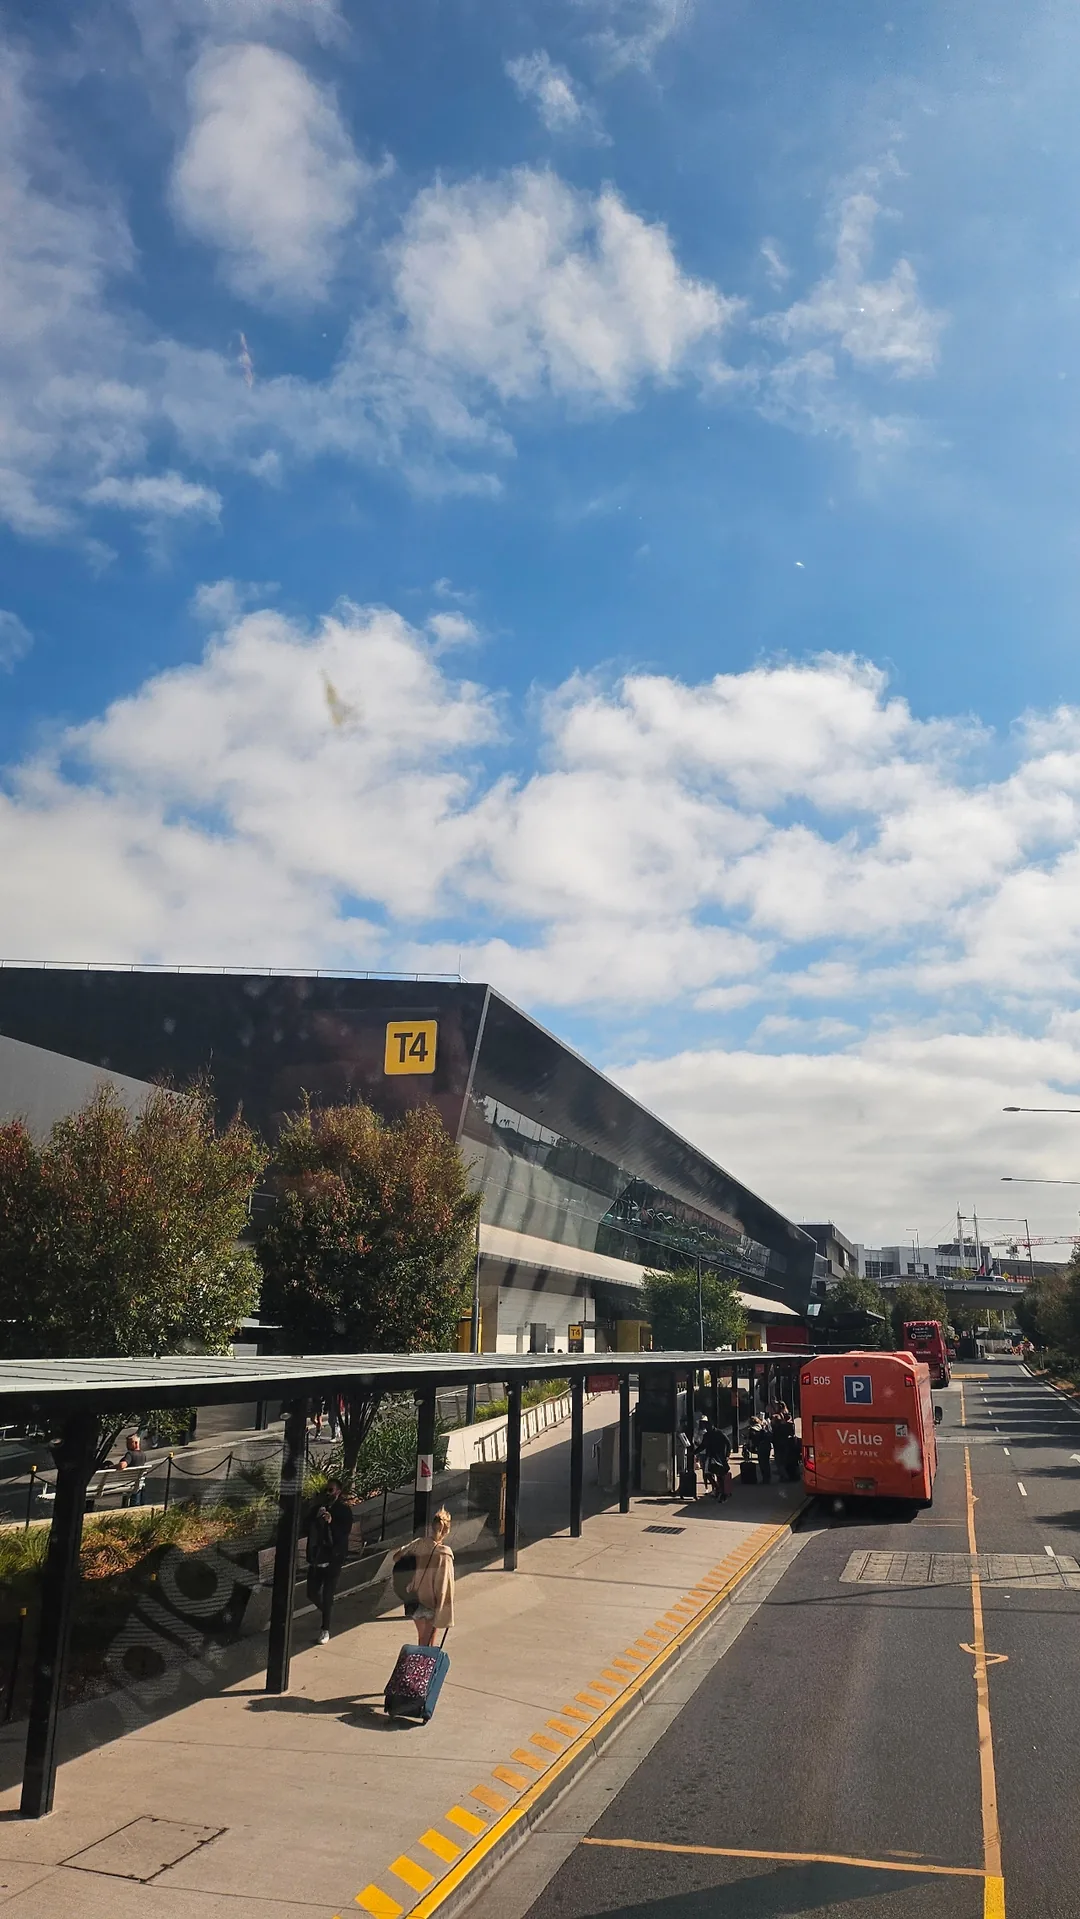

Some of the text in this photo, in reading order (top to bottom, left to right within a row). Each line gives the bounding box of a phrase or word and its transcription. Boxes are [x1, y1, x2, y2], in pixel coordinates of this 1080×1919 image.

[393, 1031, 429, 1063] T4
[813, 1376, 831, 1385] 505
[852, 1381, 865, 1398] P
[836, 1428, 883, 1446] Value
